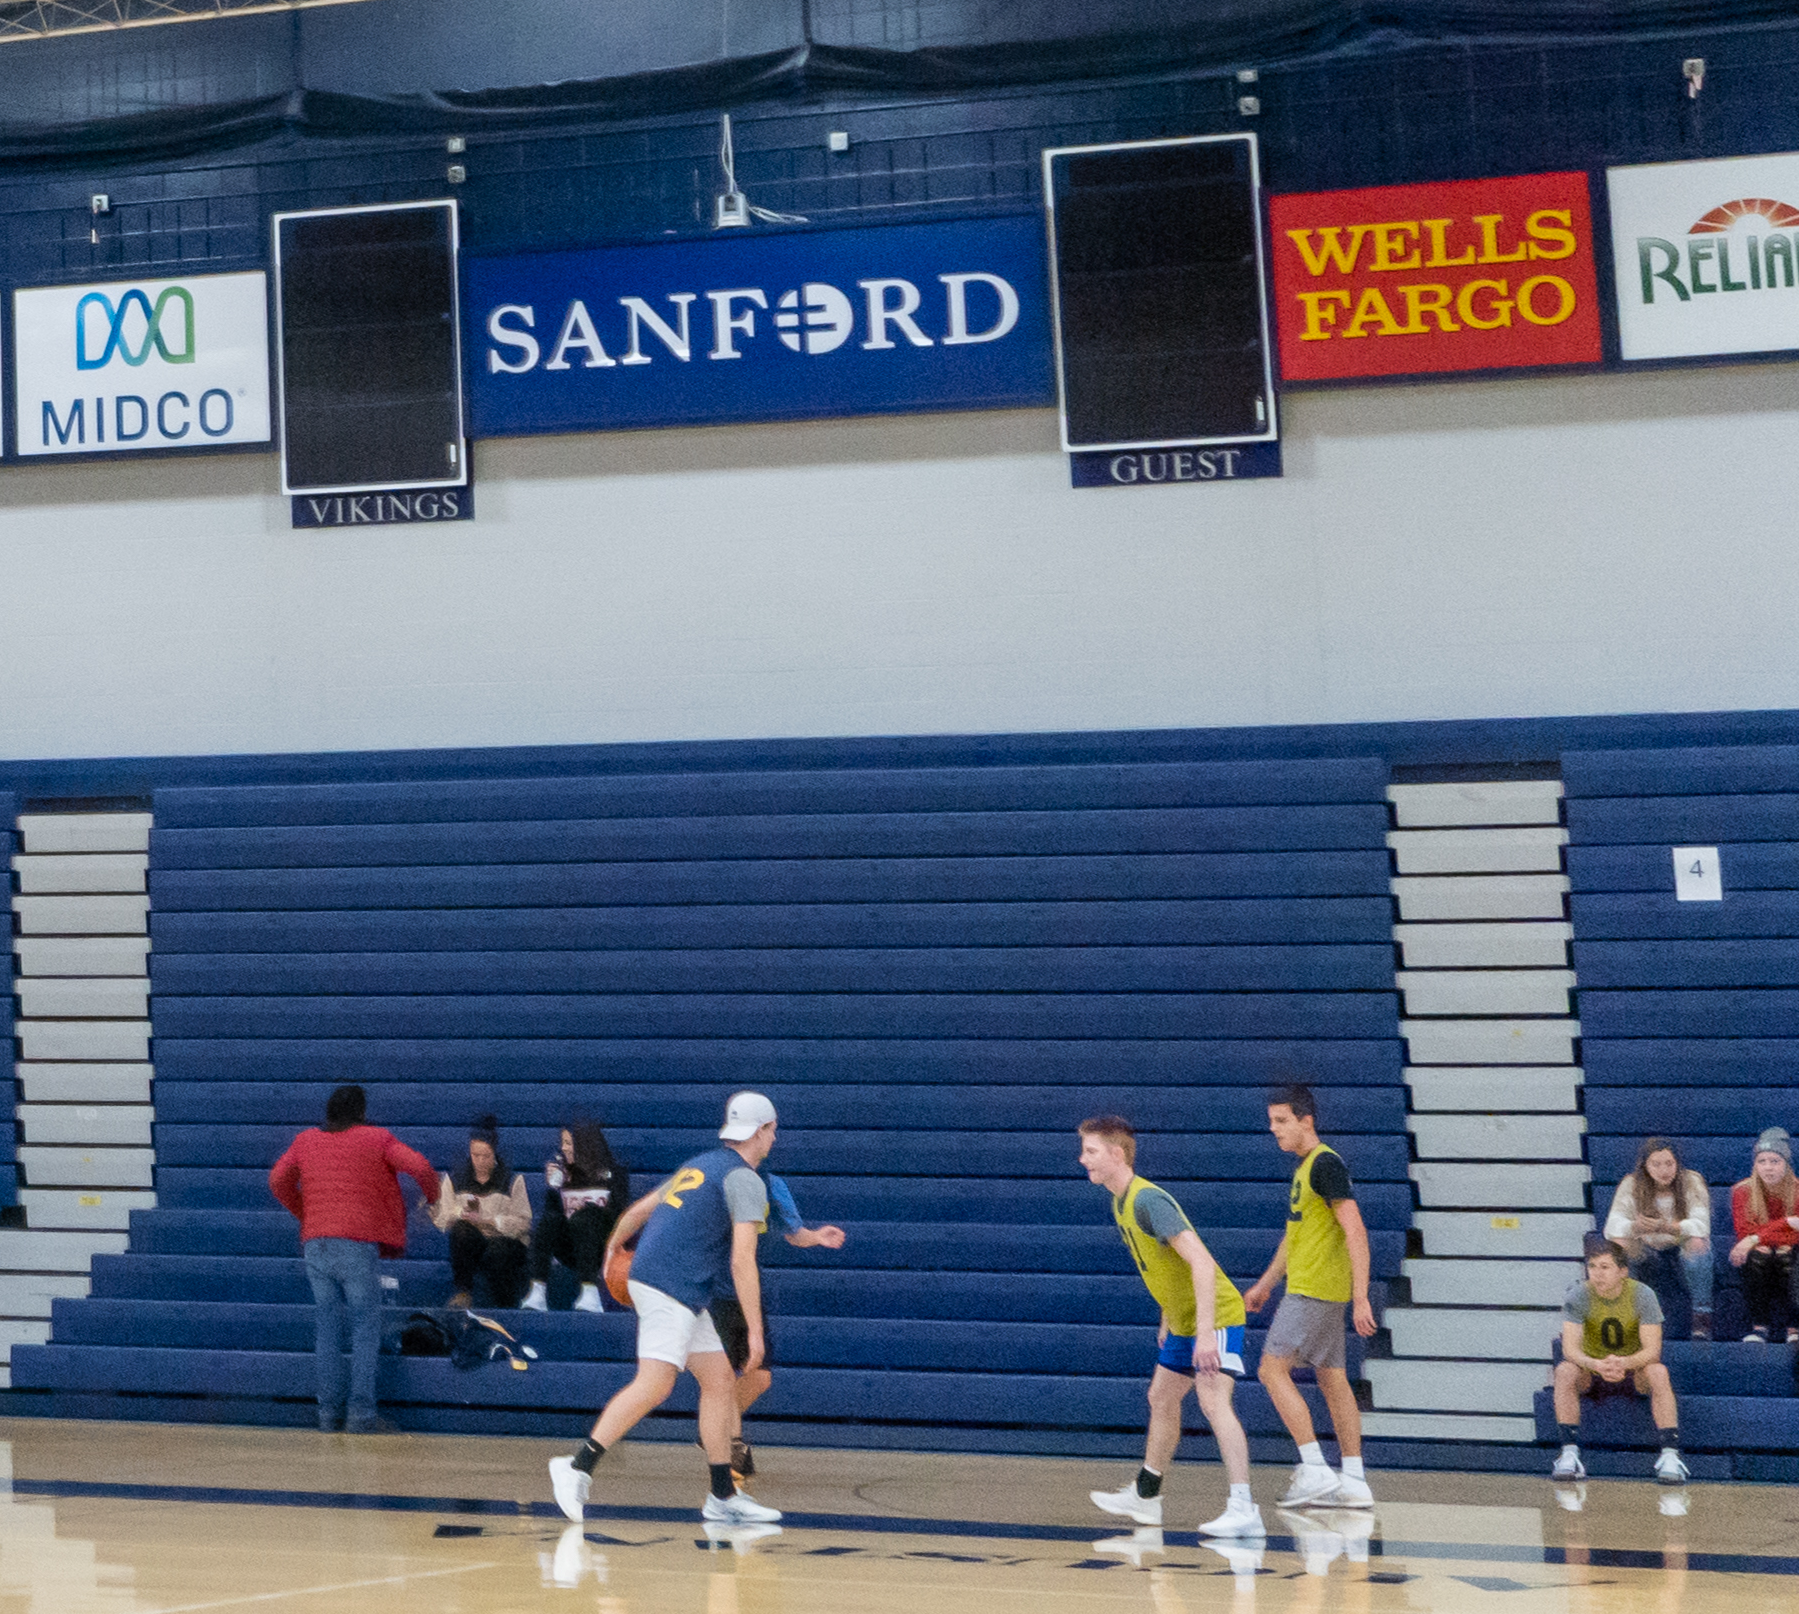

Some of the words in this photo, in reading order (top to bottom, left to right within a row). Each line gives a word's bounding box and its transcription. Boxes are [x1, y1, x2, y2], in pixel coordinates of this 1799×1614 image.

[1285, 208, 1578, 276] WELLS
[488, 271, 1021, 374] SANFORD
[1297, 275, 1578, 342] FARGO
[42, 388, 235, 446] MIDCO
[1110, 448, 1240, 483] GUEST
[311, 491, 460, 526] VIKINGS
[1689, 859, 1705, 878] 4
[1601, 1317, 1624, 1351] 0
